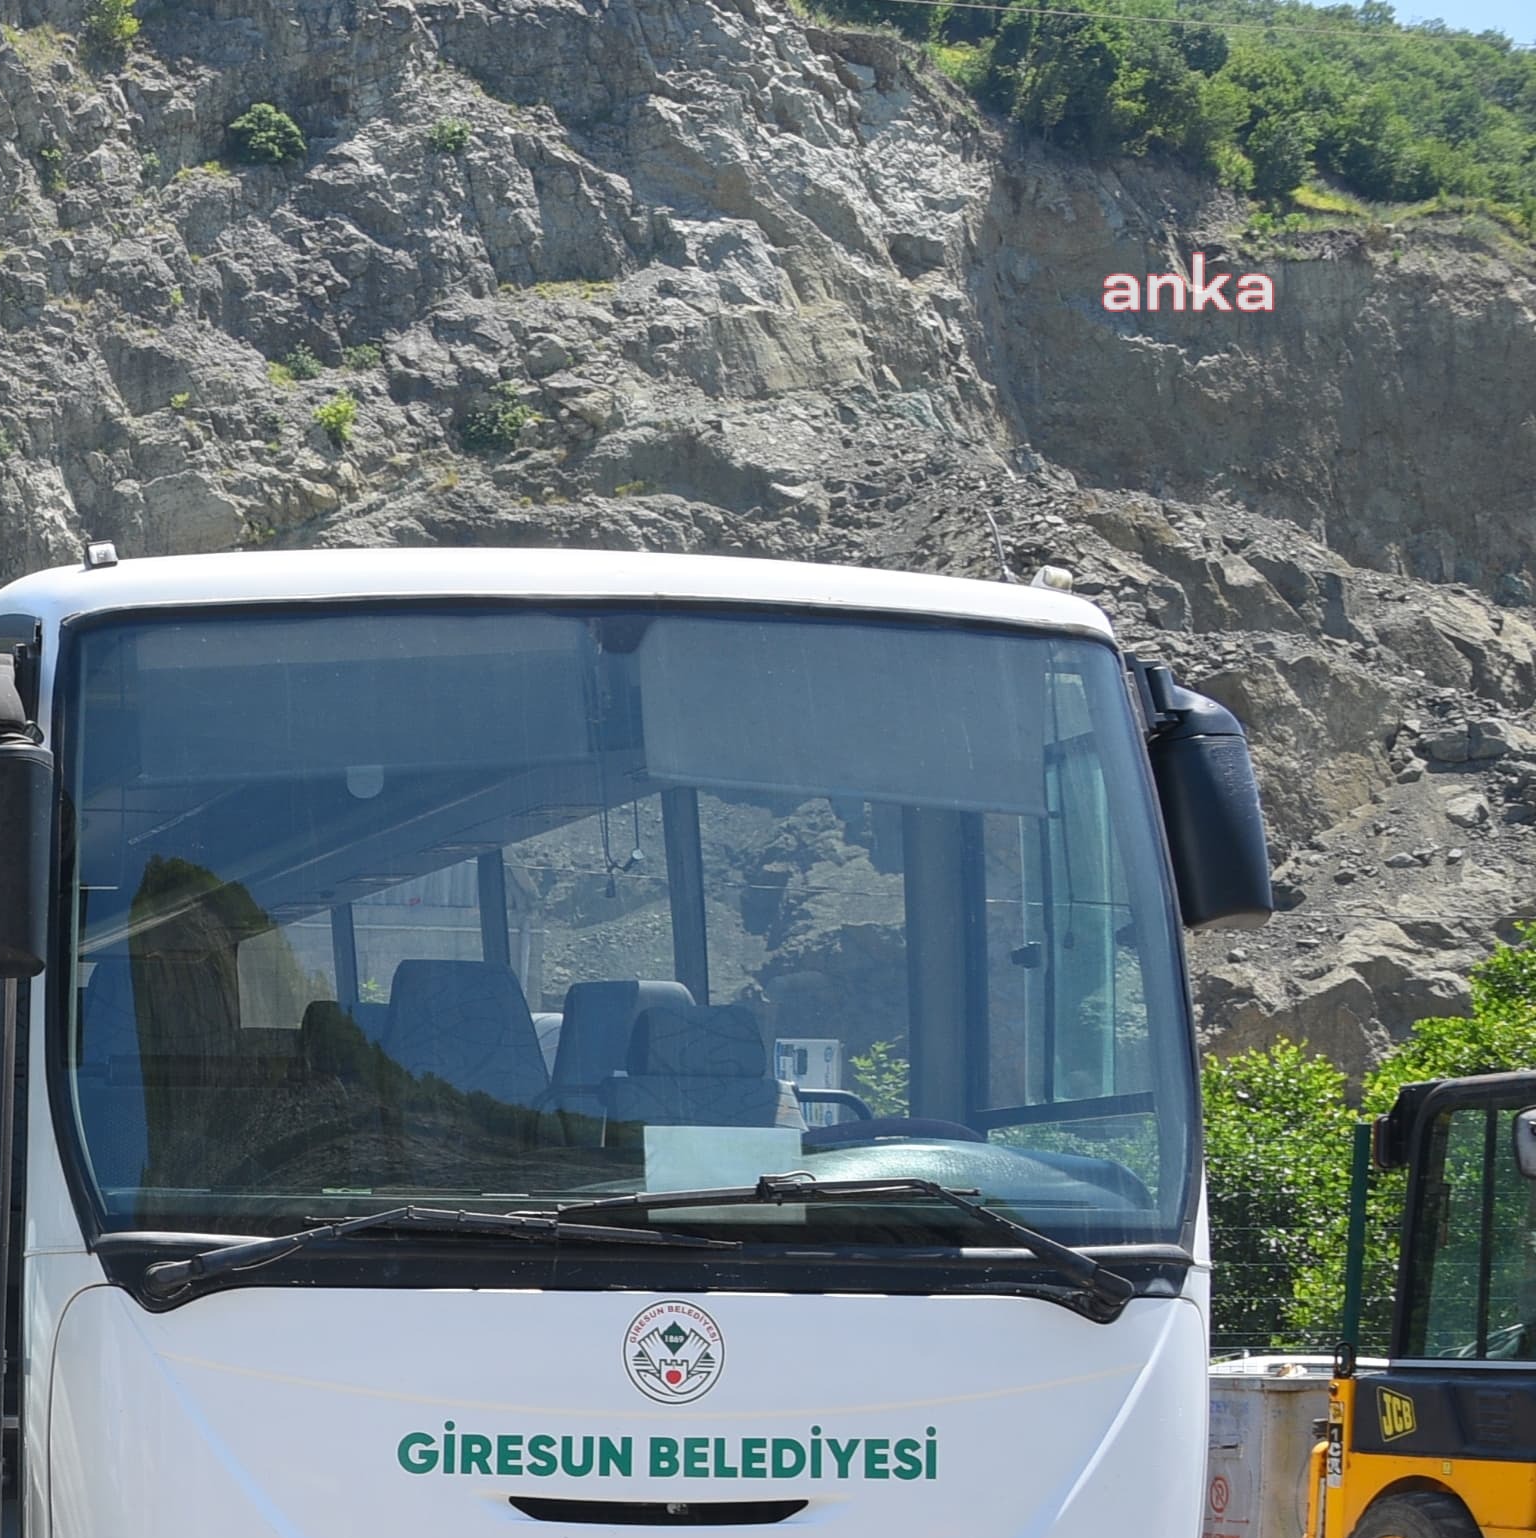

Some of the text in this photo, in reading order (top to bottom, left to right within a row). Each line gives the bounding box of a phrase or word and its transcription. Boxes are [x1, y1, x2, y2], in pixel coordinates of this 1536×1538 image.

[1383, 1392, 1413, 1436] JCB
[397, 1420, 937, 1480] GİRESUN BELEDİYESİ
